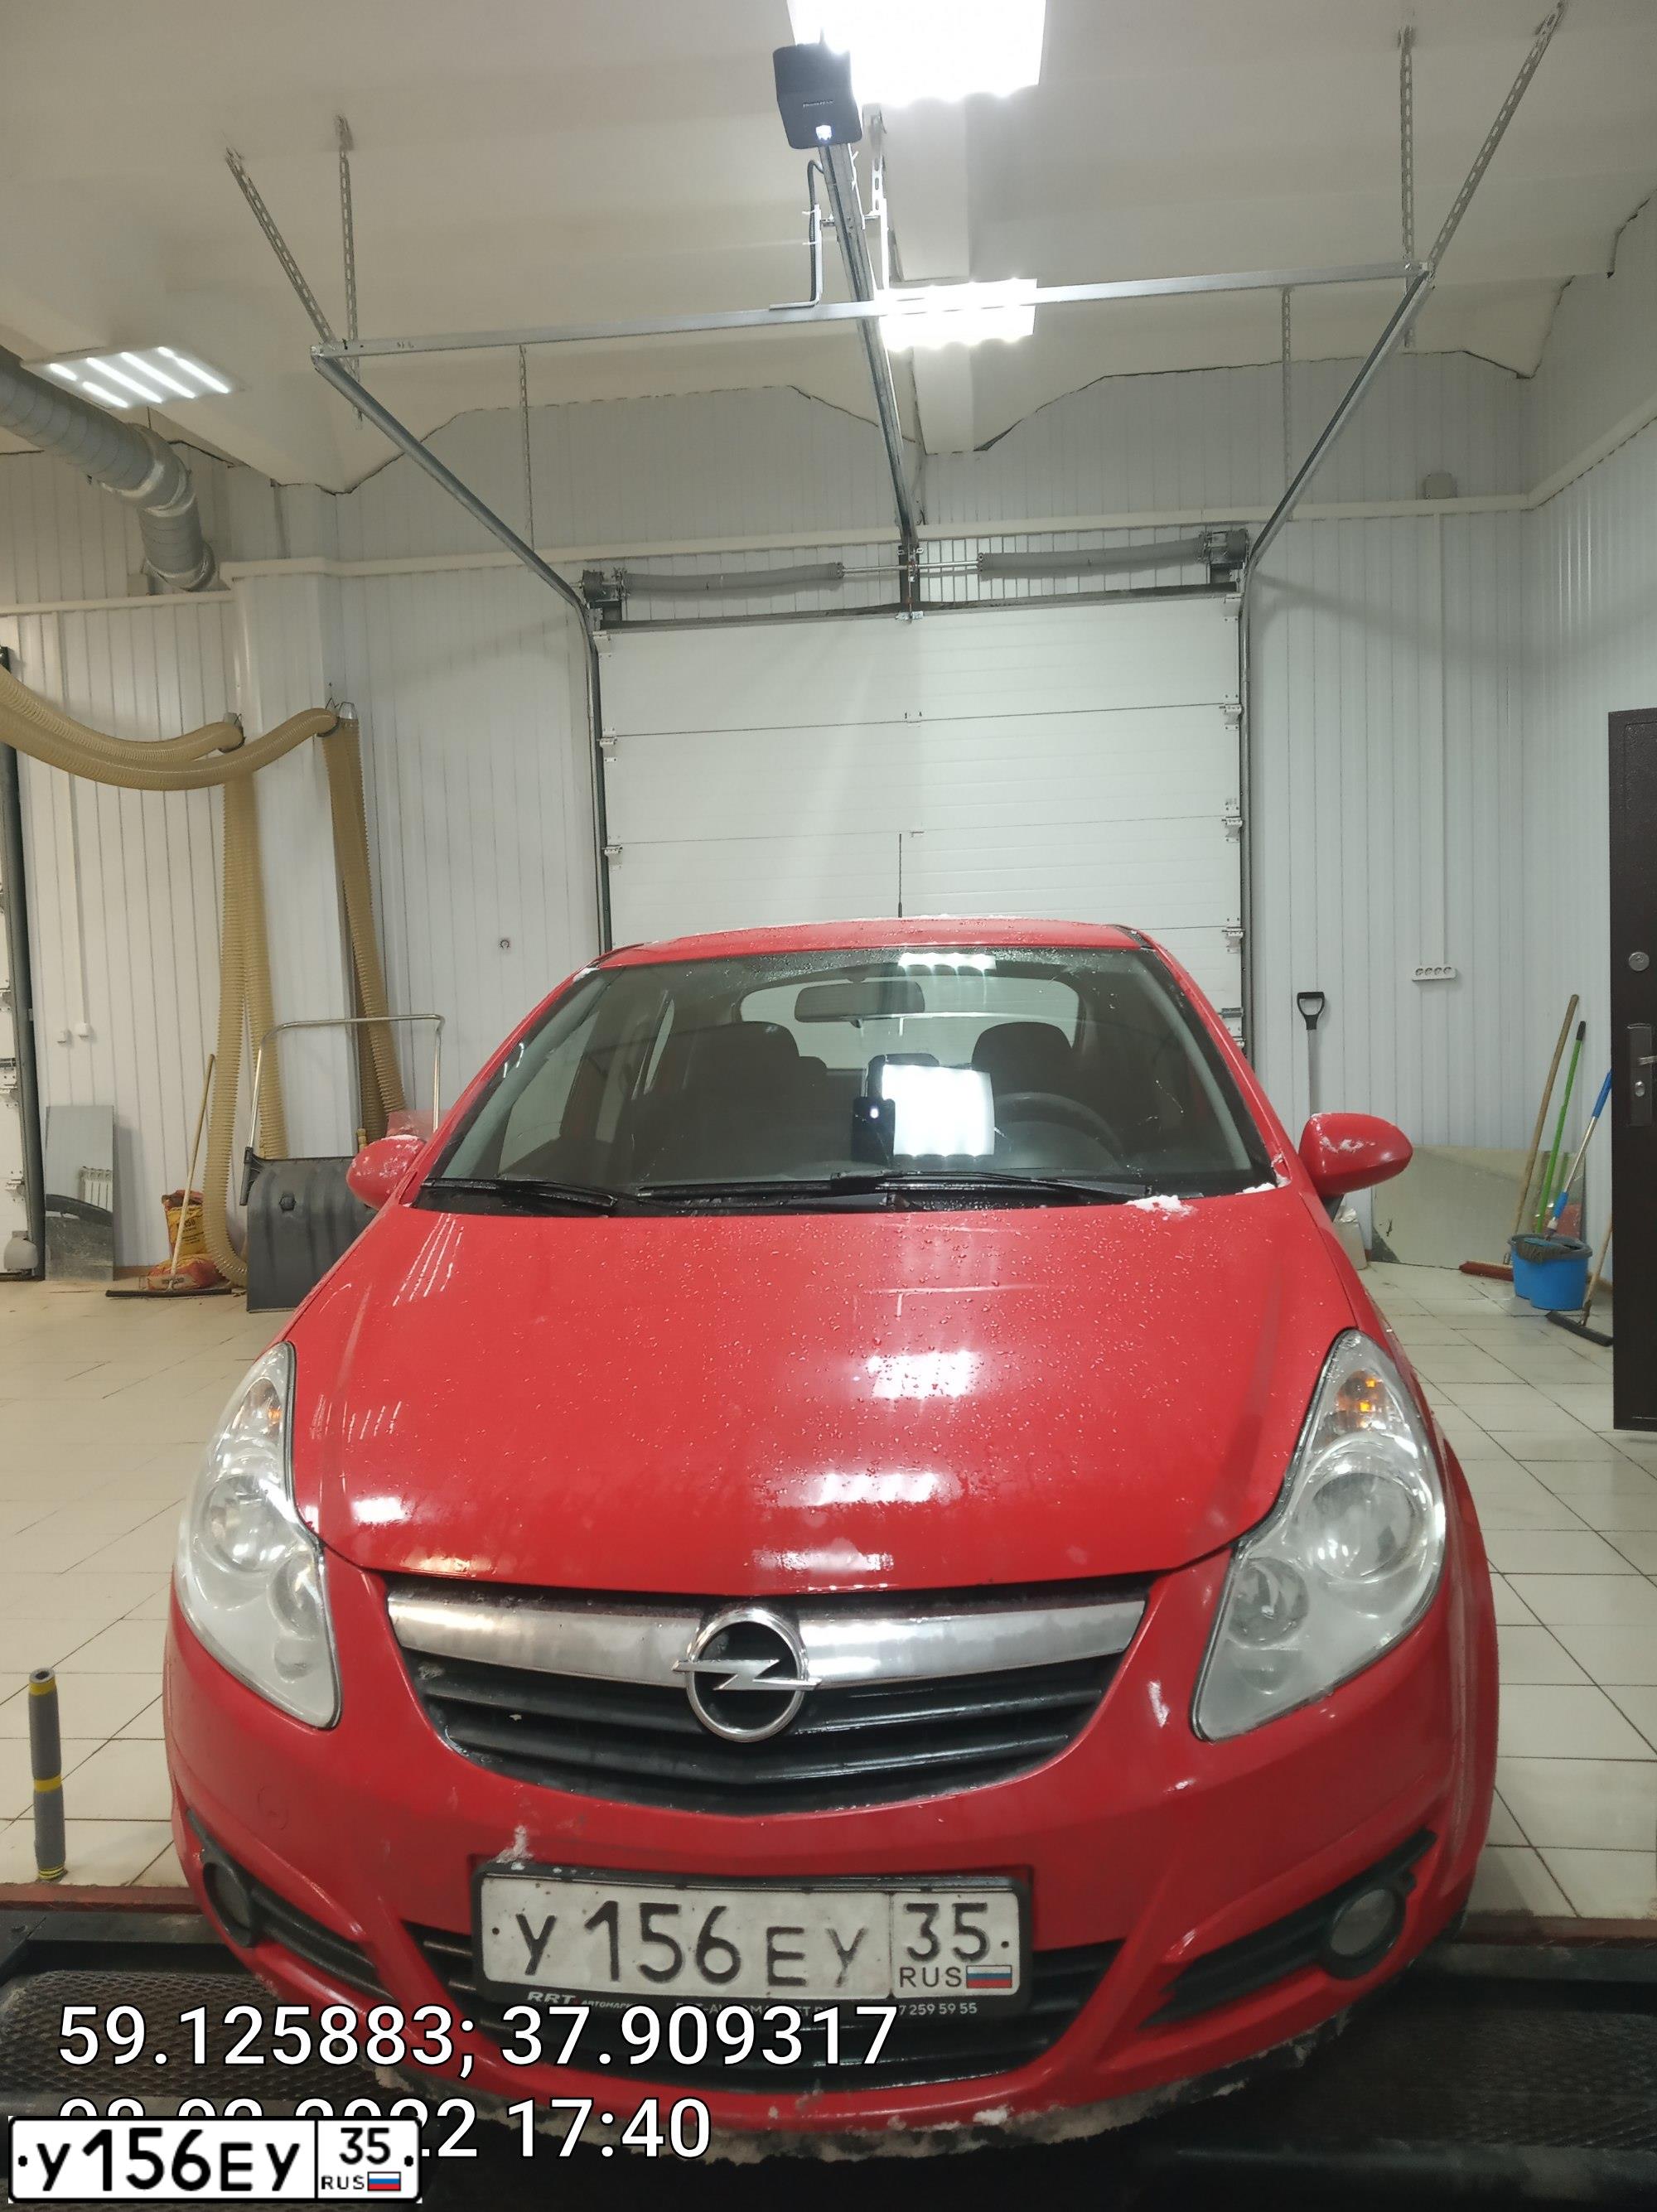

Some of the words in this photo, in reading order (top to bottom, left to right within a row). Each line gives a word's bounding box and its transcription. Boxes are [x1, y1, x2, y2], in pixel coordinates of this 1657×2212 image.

[903, 1901, 991, 1964] 35
[898, 1966, 964, 1989] RUS
[527, 1991, 577, 2006] RRT
[910, 2003, 935, 2016] 259
[939, 2002, 957, 2015] 59
[959, 2002, 978, 2014] 55
